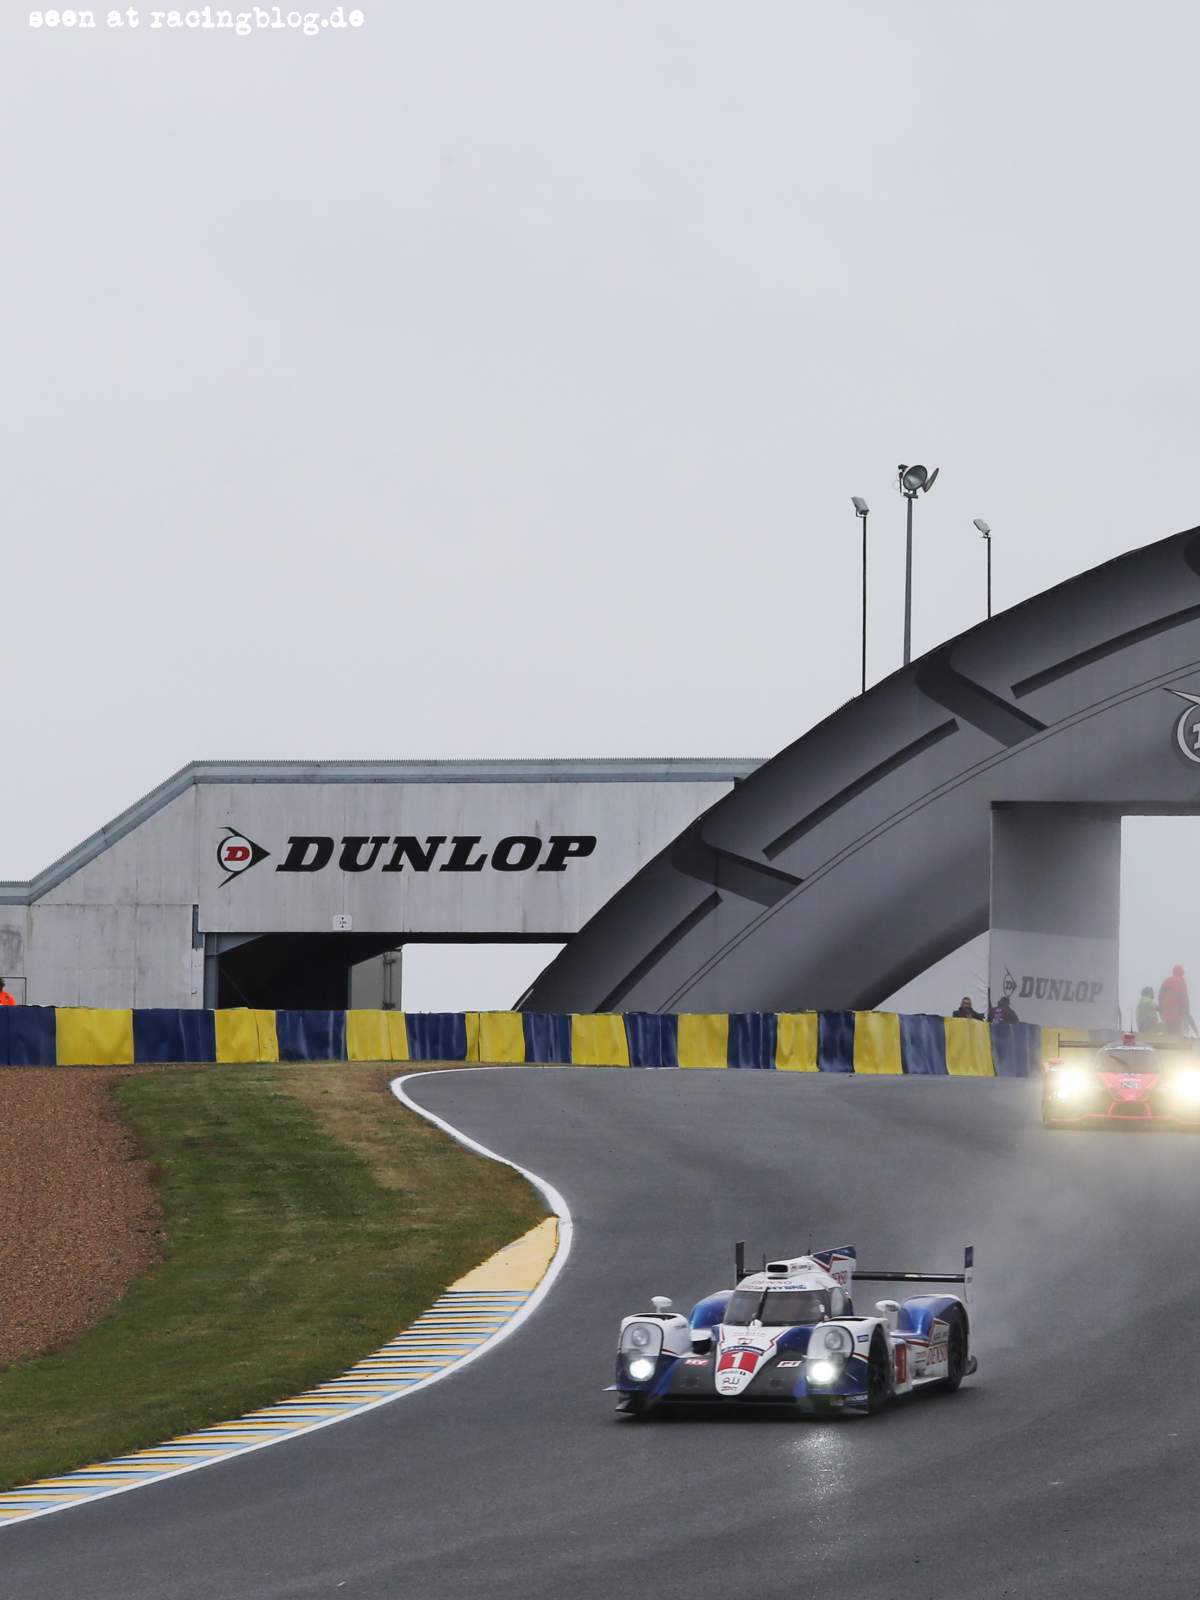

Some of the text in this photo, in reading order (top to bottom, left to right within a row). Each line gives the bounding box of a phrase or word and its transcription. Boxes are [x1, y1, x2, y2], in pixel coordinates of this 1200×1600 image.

[276, 836, 597, 872] DUNLOP
[1019, 976, 1104, 1004] DUNLOP
[730, 1352, 744, 1369] 1
